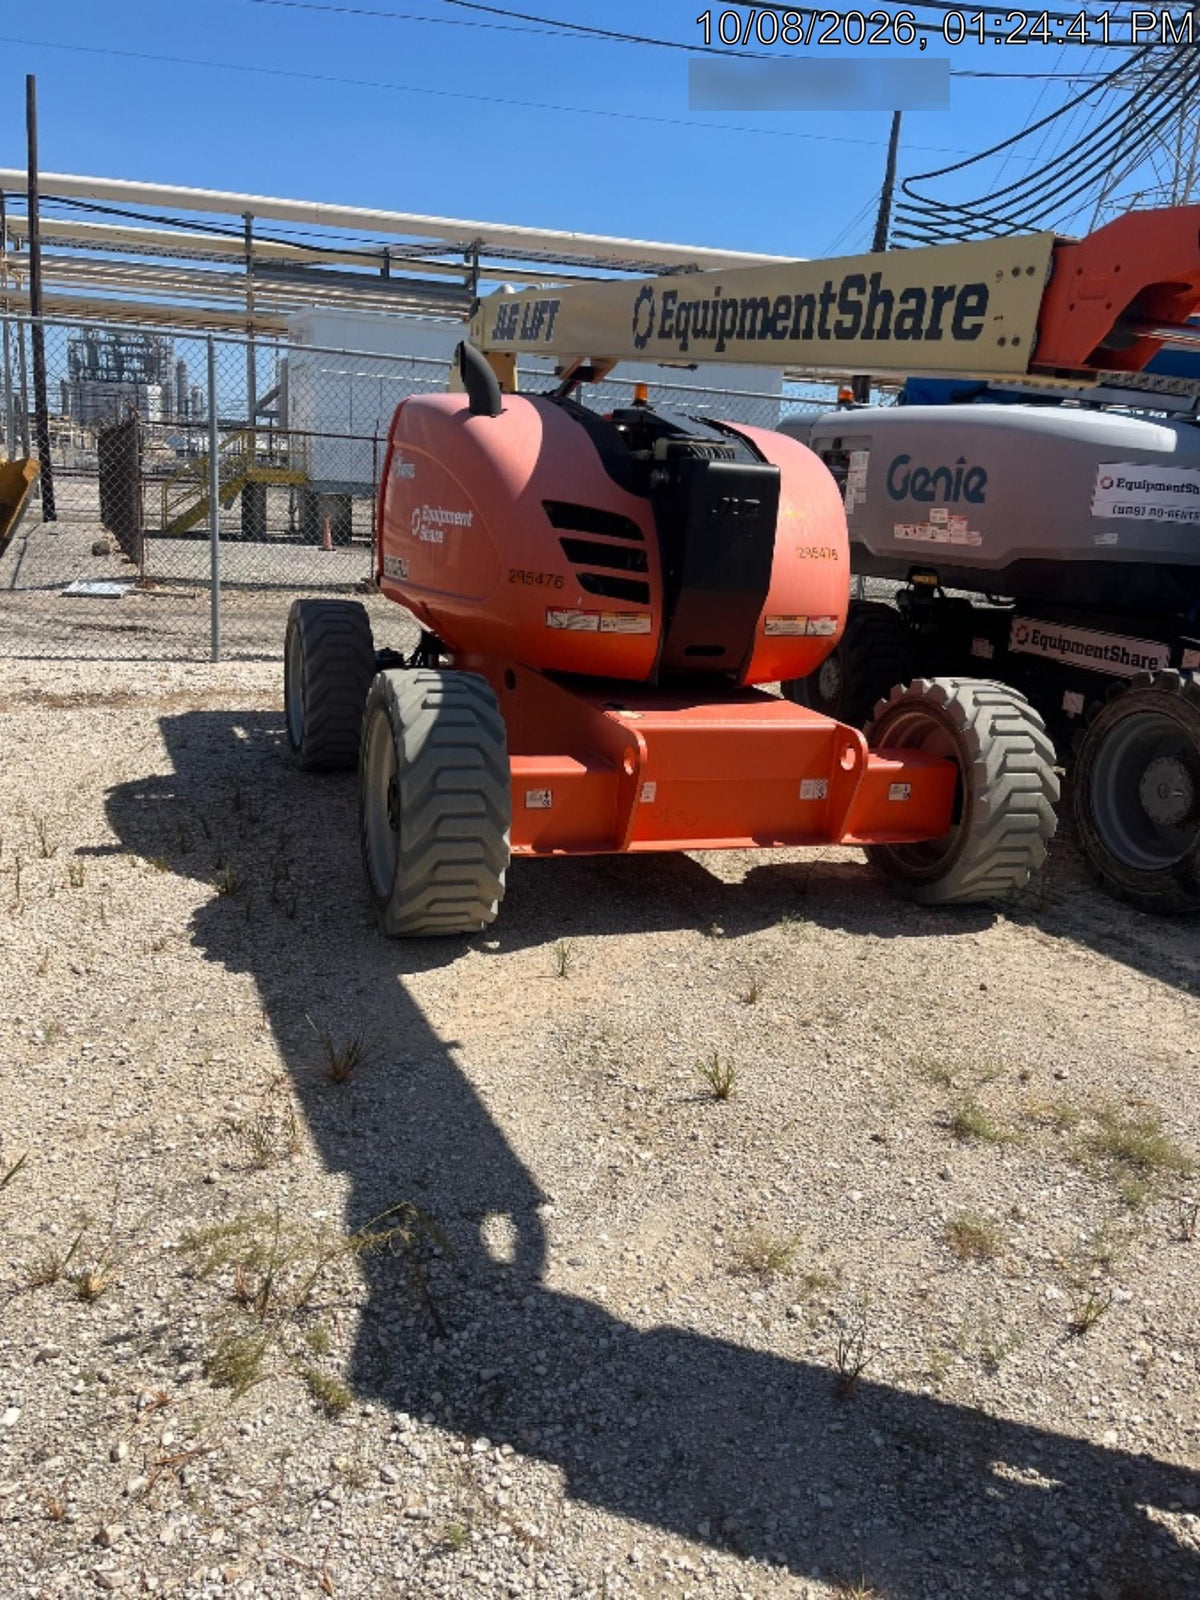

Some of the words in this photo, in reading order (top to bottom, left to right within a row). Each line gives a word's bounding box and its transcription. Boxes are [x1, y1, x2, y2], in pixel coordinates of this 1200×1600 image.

[520, 300, 560, 341] LIFT
[658, 272, 989, 352] EquipmentShare
[886, 454, 988, 503] Genie
[508, 569, 564, 589] 295476
[1031, 629, 1159, 671] EquipmentShare
